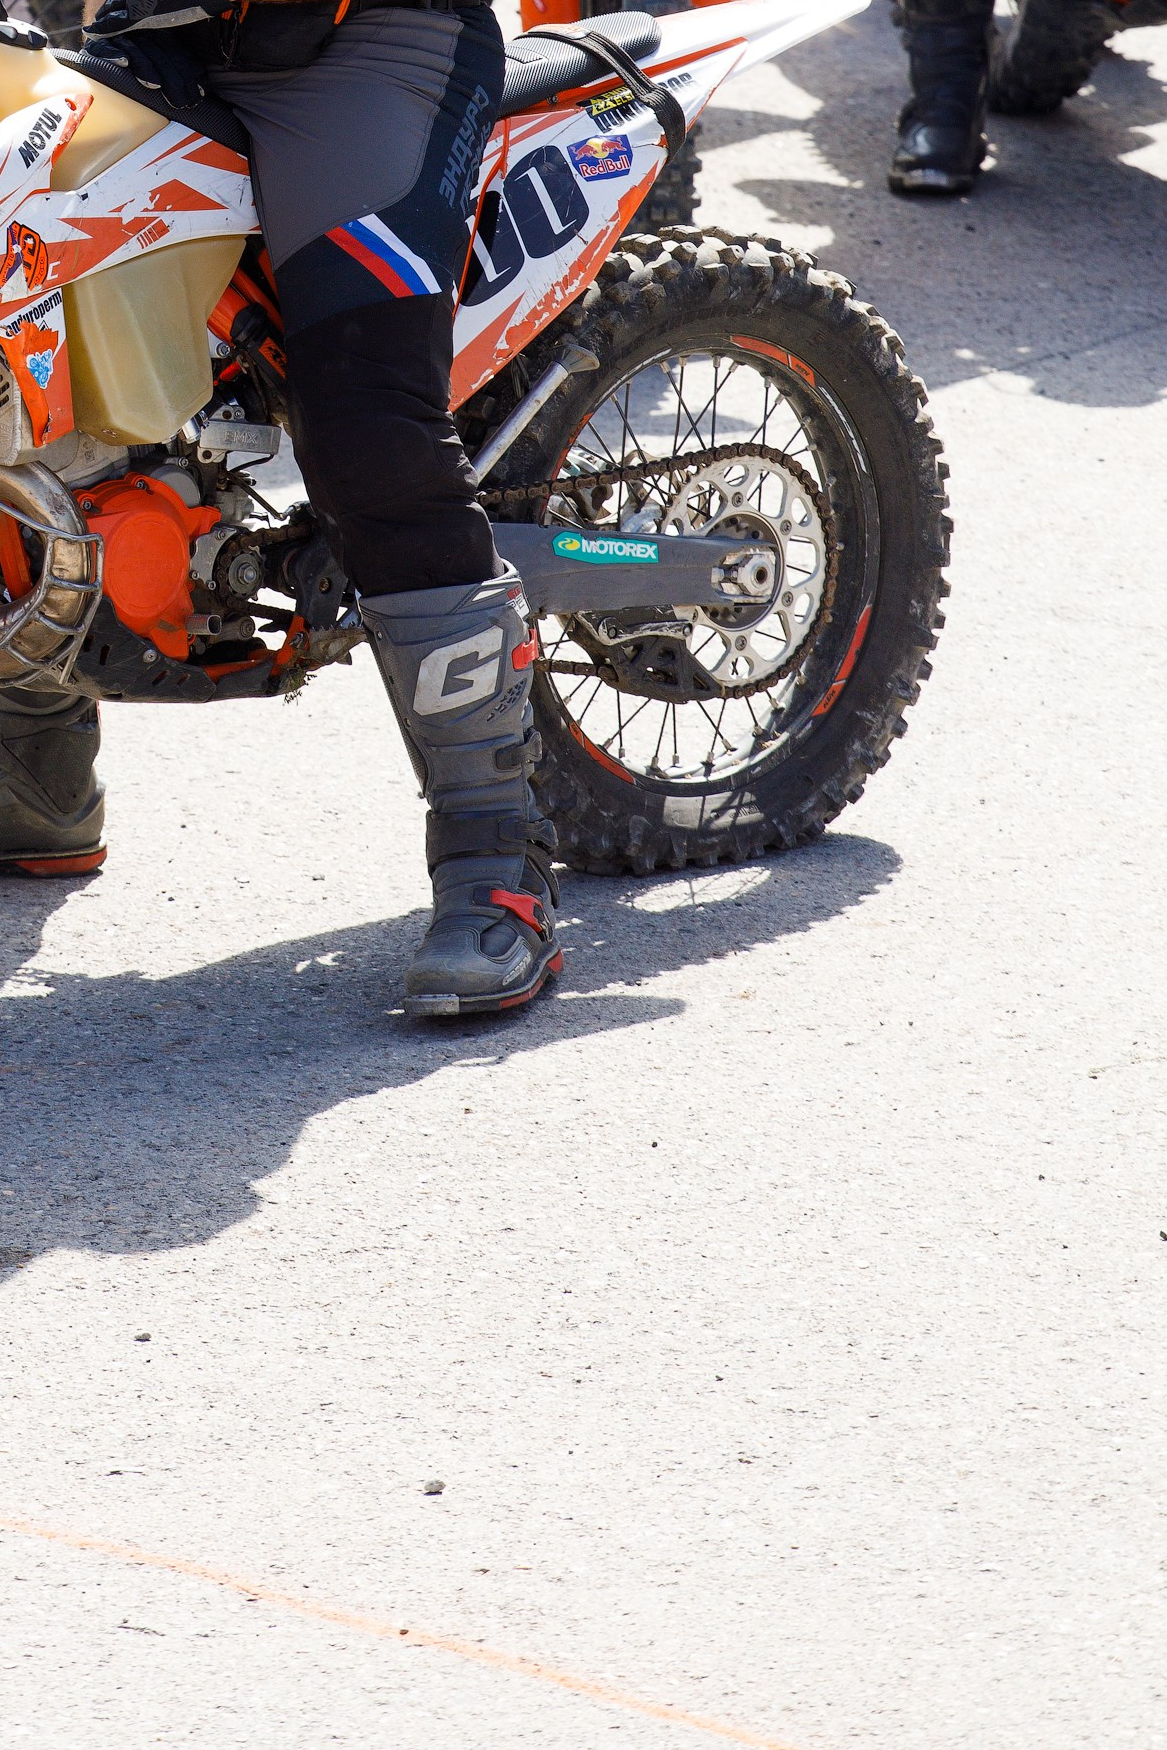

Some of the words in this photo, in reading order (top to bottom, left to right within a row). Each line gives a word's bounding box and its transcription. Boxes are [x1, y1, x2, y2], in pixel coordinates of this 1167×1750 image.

[18, 108, 63, 169] MOTUL
[439, 84, 490, 208] ЭНДУРО
[580, 160, 606, 177] Red
[606, 155, 631, 174] Bull
[6, 290, 63, 337] enduroperm
[582, 539, 657, 559] MOTOREX
[413, 625, 506, 717] G
